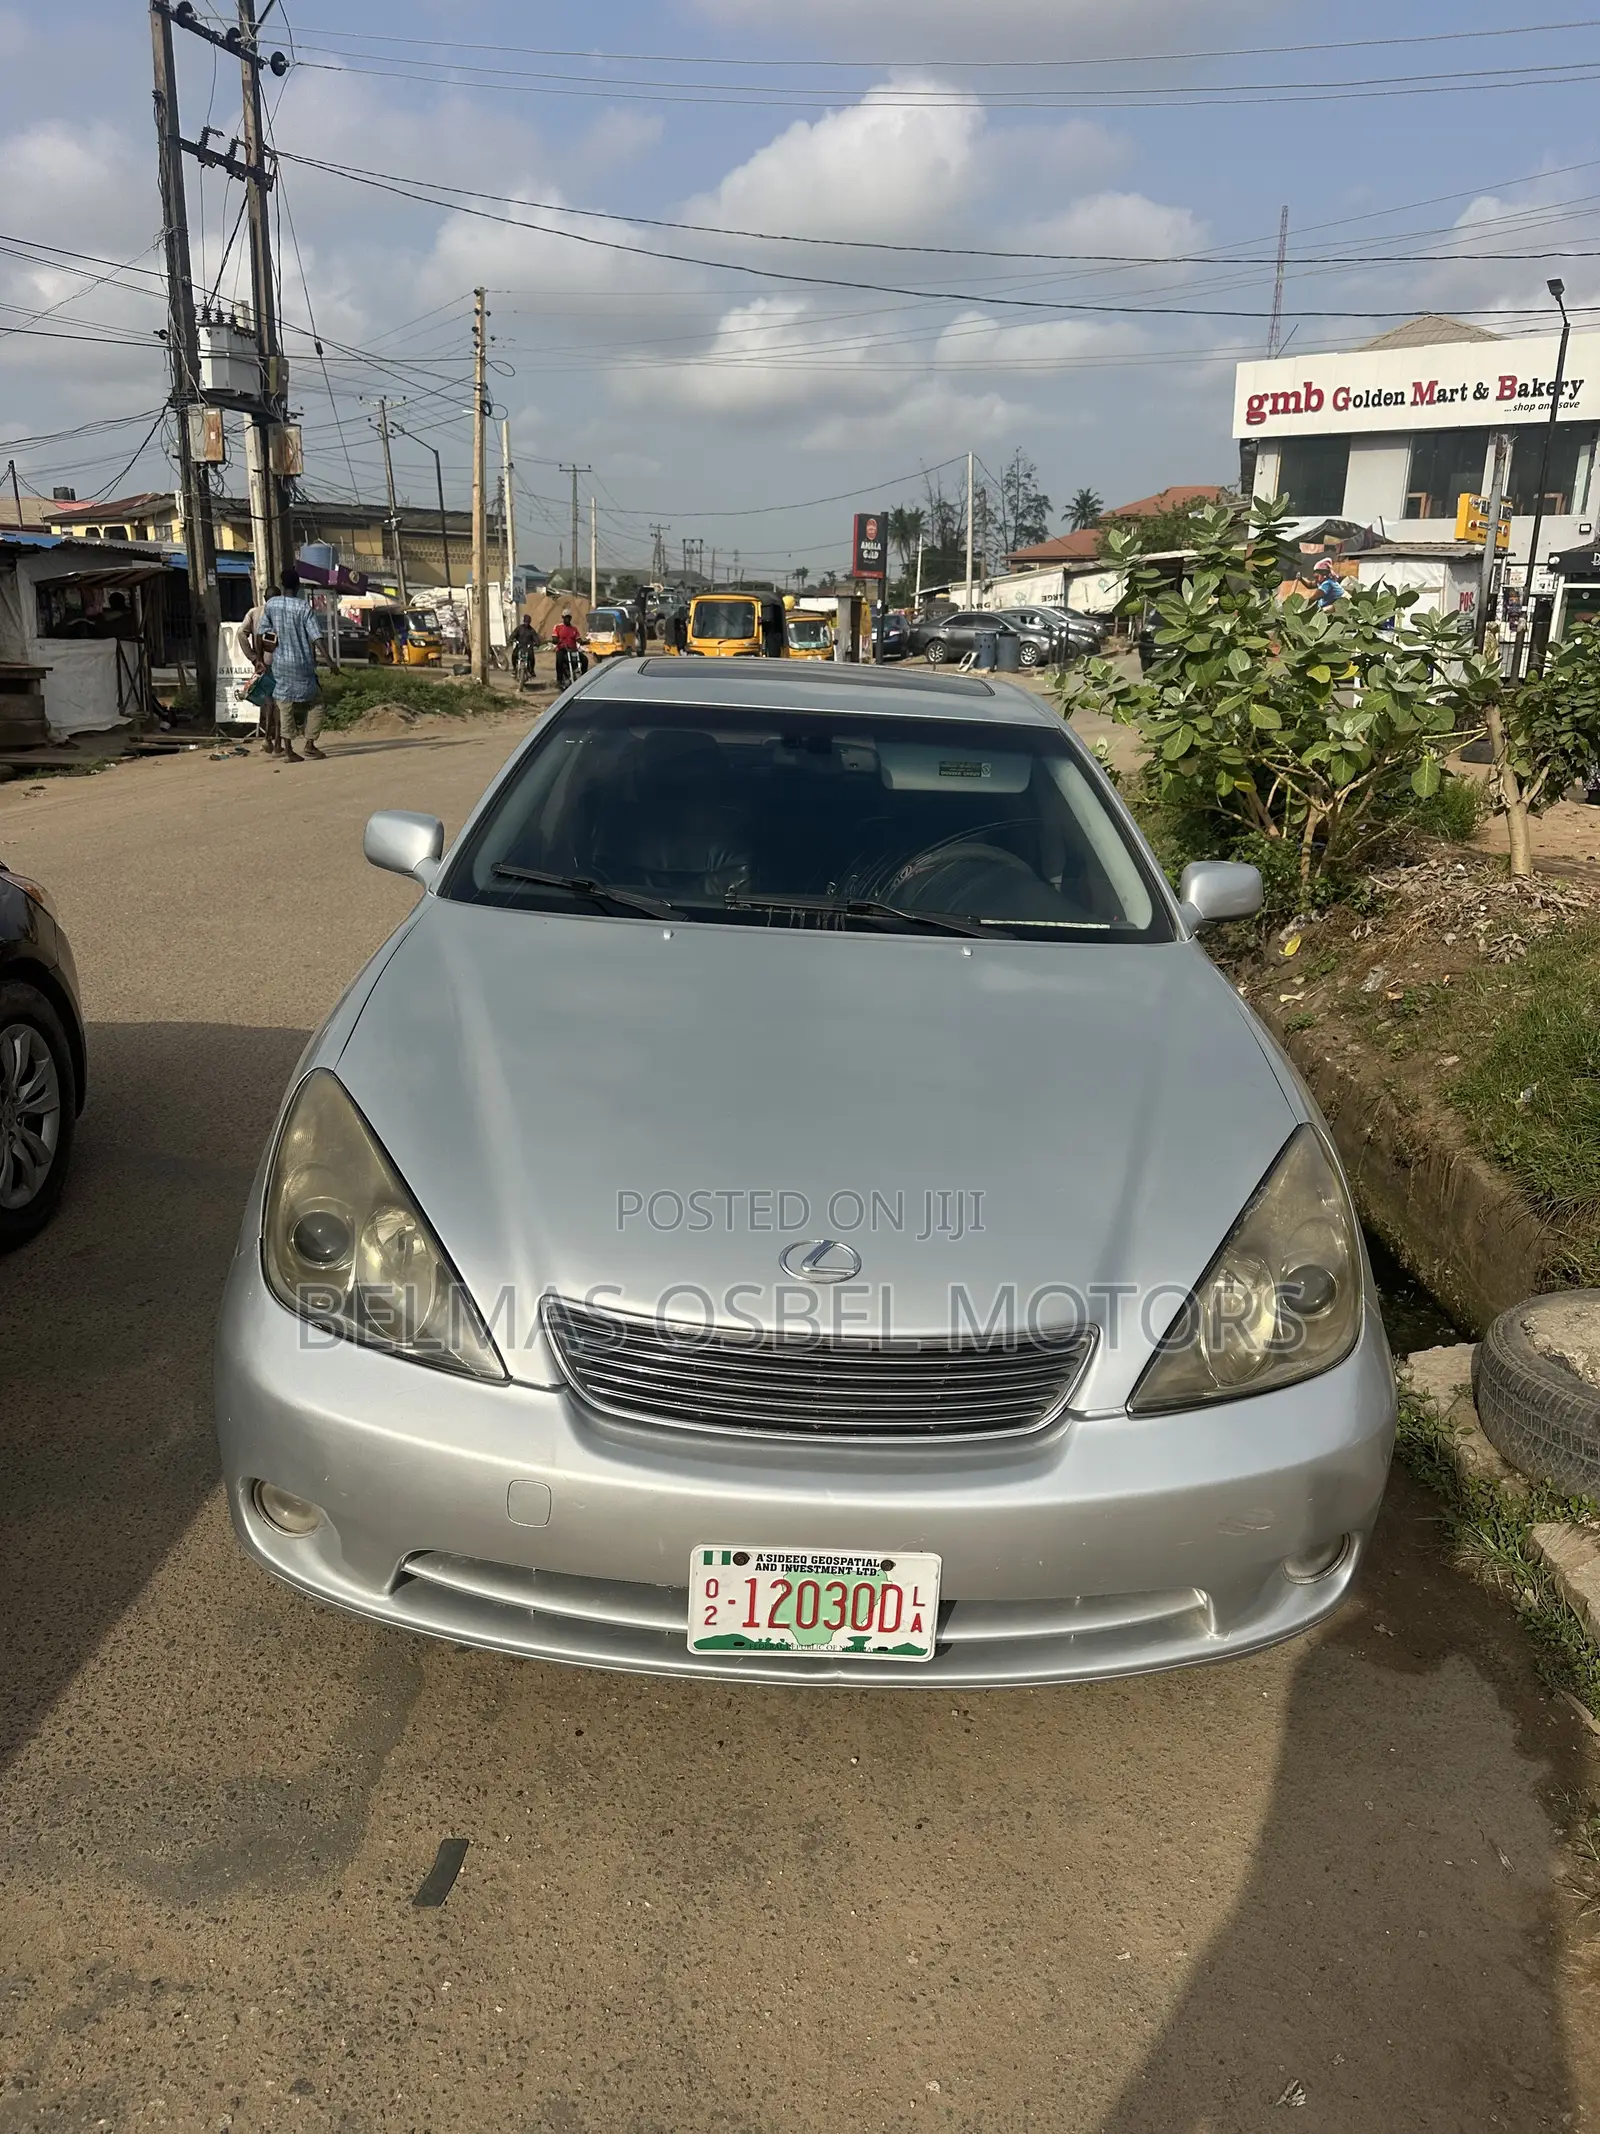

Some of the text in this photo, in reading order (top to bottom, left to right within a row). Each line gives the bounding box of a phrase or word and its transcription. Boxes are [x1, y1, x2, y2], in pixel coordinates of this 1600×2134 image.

[1246, 375, 1585, 425] gmb Golden Mart & Bakery
[1538, 402, 1557, 411] an
[1558, 401, 1580, 409] save
[860, 541, 882, 550] AMALA
[810, 1555, 880, 1568] GEOSPATIAL
[755, 1563, 880, 1577] AND INVESTMENT LTD.
